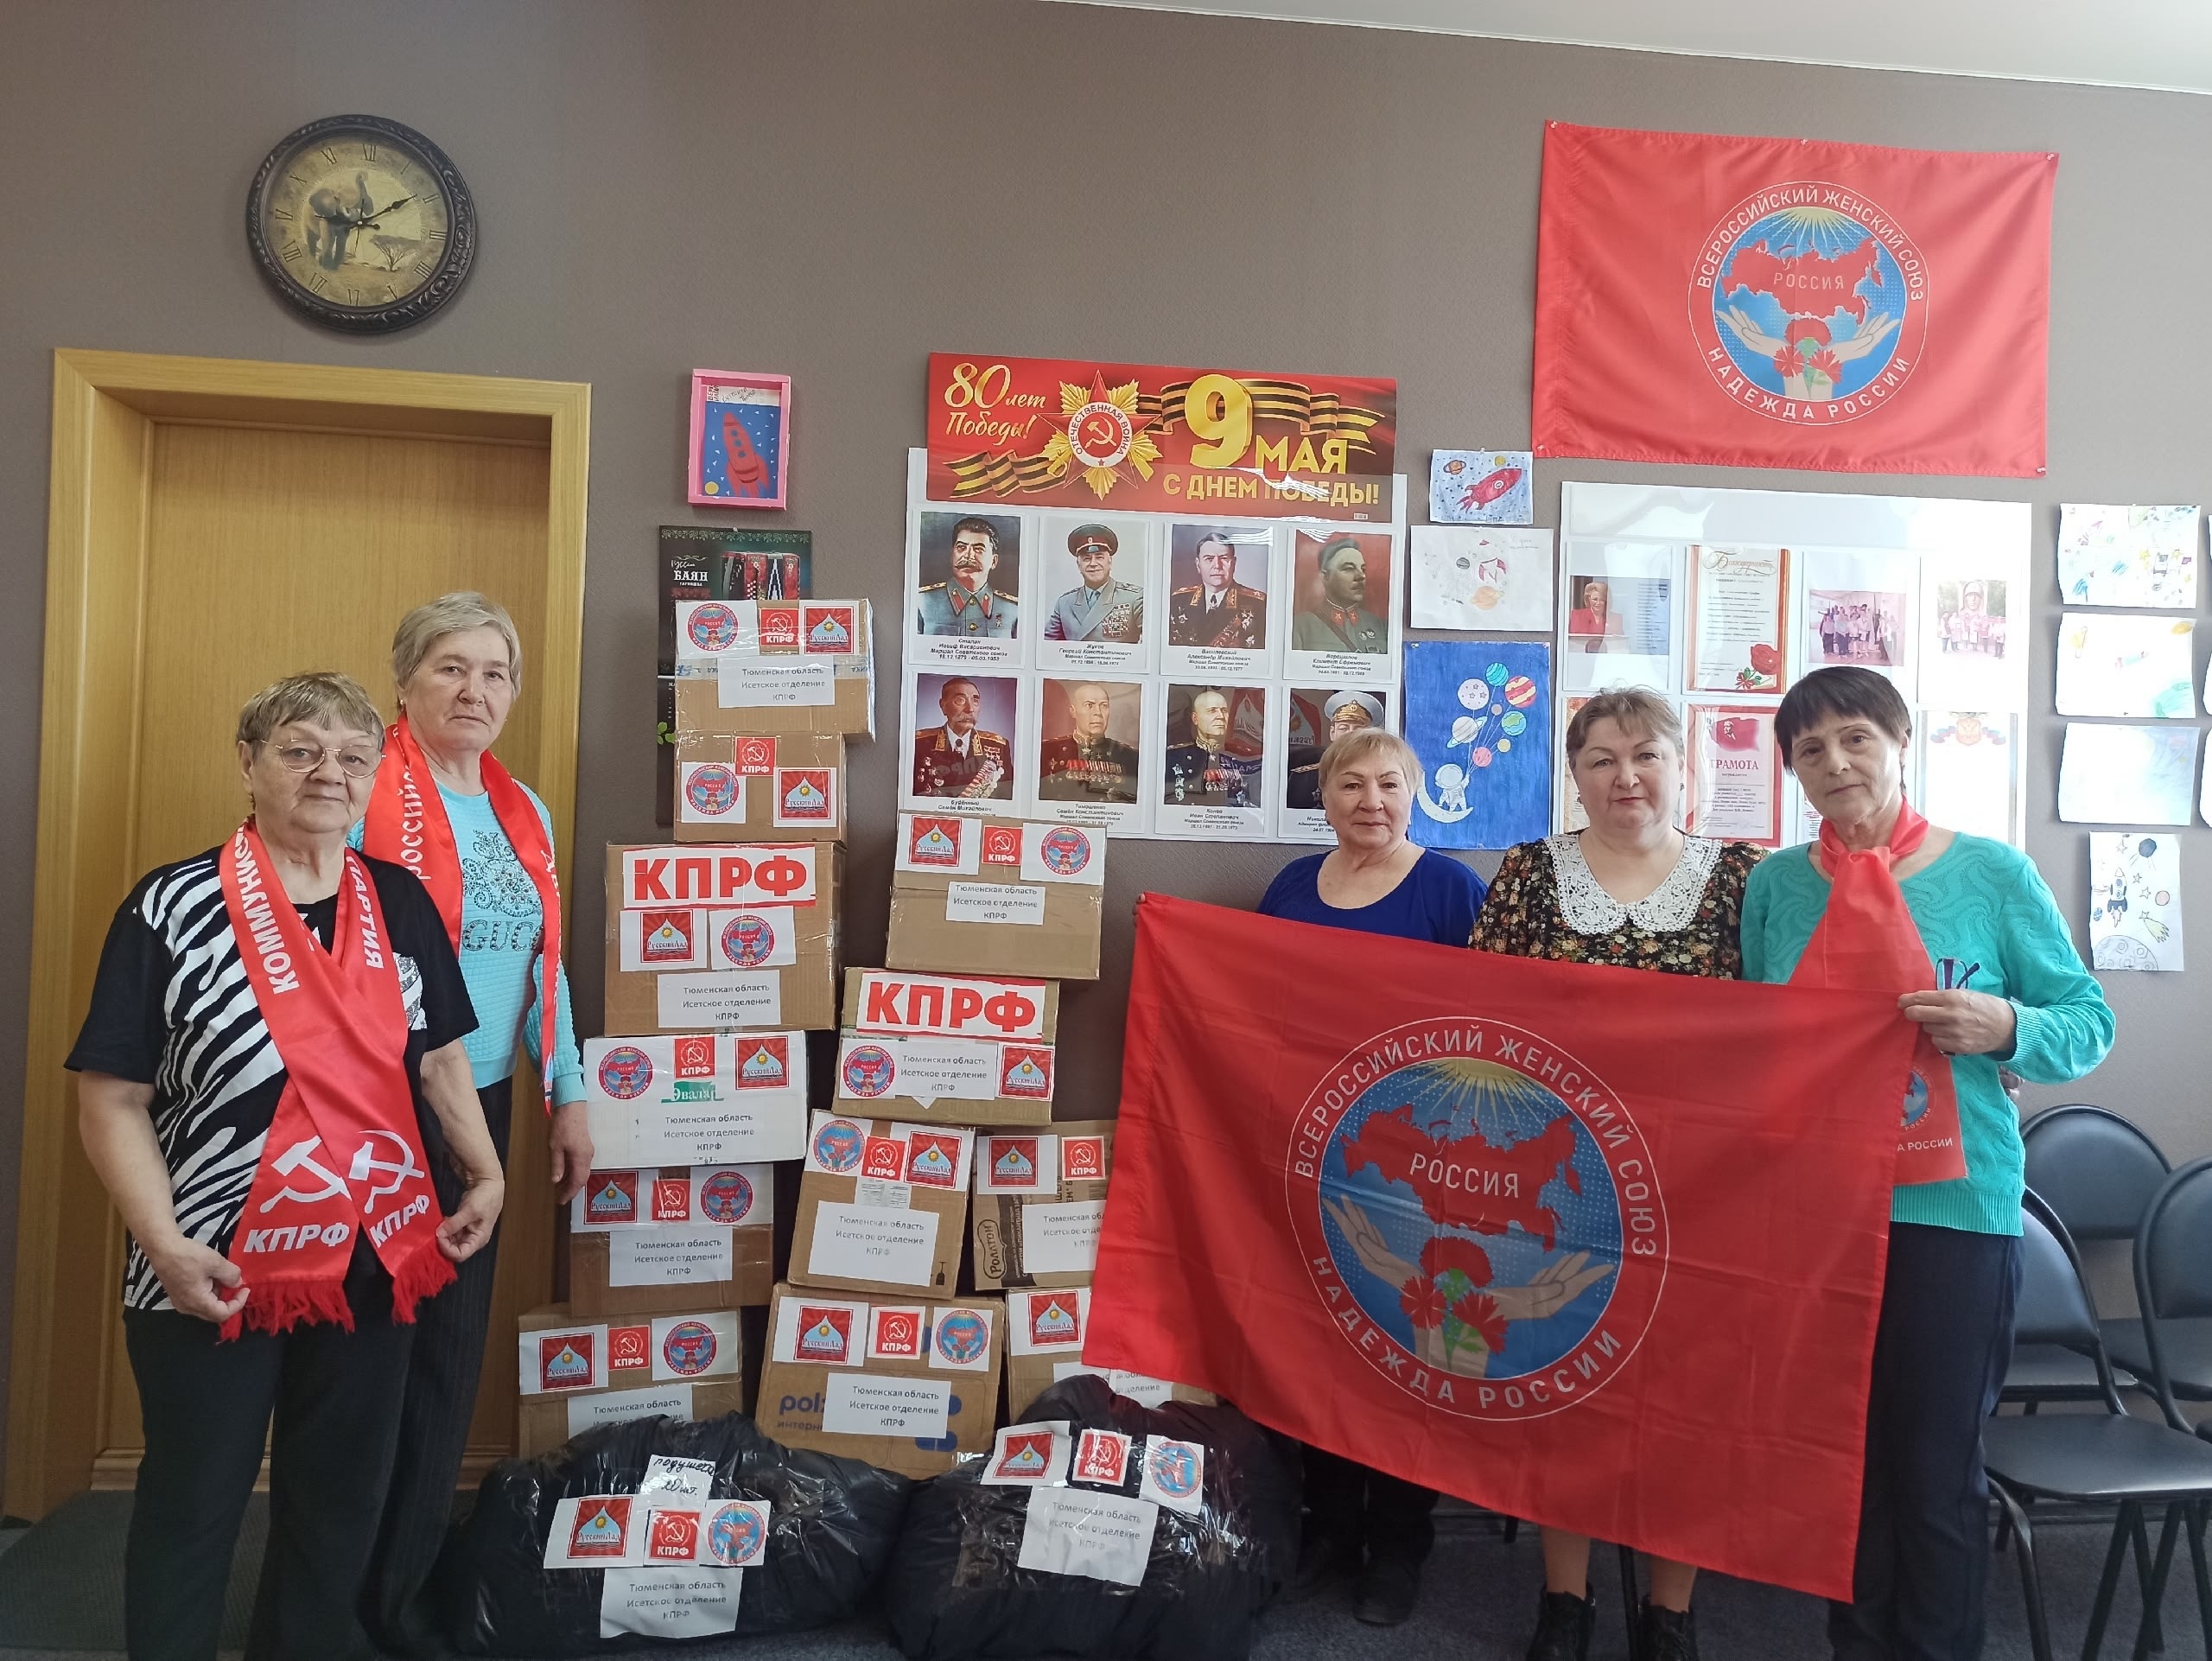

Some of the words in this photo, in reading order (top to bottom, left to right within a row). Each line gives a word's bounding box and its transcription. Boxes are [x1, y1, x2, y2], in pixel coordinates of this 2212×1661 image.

[1697, 185, 1818, 289] ВСЕРОССИЙСКИЙ
[1822, 190, 1904, 250] ЖЕНСКИЙ
[1897, 249, 1924, 301] СОЮЗ
[1773, 273, 1845, 290] РОССИЯ
[944, 362, 1011, 409] 80
[1005, 394, 1046, 408] лет
[1708, 347, 1815, 419] НАДЕЖДА
[1827, 359, 1910, 417] РОССИИ
[946, 411, 1038, 445] Победы!
[1071, 405, 1123, 455] ОТЕЧЕСТВЕННАЯ
[1116, 422, 1130, 455] ВОЙНА
[1185, 374, 1253, 468] 9
[1255, 435, 1347, 474] МАЯ
[1163, 474, 1180, 494] С
[1186, 475, 1257, 500] ДНЕМ
[1264, 479, 1379, 506] ПОБЕДЫ!
[674, 570, 708, 582] БАЯН
[766, 634, 794, 643] КПРФ
[741, 765, 770, 773] КПРФ
[1710, 759, 1758, 770] ГРАМОТА
[988, 853, 1015, 862] КПРФ
[634, 855, 807, 901] КПРФ
[956, 885, 1002, 894] Тюменская
[954, 898, 991, 907] Исетское
[346, 856, 385, 968] ПАРТИЯ
[684, 986, 733, 995] Тюменская
[683, 1000, 722, 1009] Исетское
[725, 998, 771, 1007] отделение
[867, 981, 1036, 1032] КПРФ
[715, 1012, 740, 1021] КПРФ
[903, 1055, 950, 1064] Тюменская
[681, 1066, 710, 1076] КПРФ
[665, 1116, 715, 1124] Тюменская
[1905, 1107, 1931, 1132] РОССИИ
[664, 1130, 704, 1138] Исетское
[707, 1128, 754, 1136] отделение
[697, 1142, 721, 1151] КПРФ
[1294, 1025, 1484, 1179] ВСЕРОССИЙСКИЙ
[1496, 1035, 1634, 1149] ЖЕНСКИЙ
[1618, 1158, 1657, 1256] СОЮЗ
[1908, 1137, 1953, 1151] РОССИИ
[868, 1167, 896, 1177] КПРФ
[1071, 1167, 1096, 1175] КПРФ
[1409, 1154, 1519, 1198] РОССИЯ
[658, 1210, 686, 1219] КПРФ
[369, 1194, 429, 1248] КПРФ
[839, 1216, 887, 1227] Тюменская
[891, 1221, 924, 1231] область
[243, 1222, 349, 1253] КПРФ
[877, 1234, 924, 1244] отделение
[1313, 1257, 1454, 1403] НАДЕЖДА
[1478, 1329, 1622, 1409] РОССИИ
[881, 1342, 911, 1352] КПРФ
[614, 1358, 644, 1367] КПРФ
[853, 1386, 902, 1397] Тюменская
[905, 1391, 939, 1399] область
[594, 1403, 644, 1414] Тюменская
[647, 1399, 681, 1408] область
[779, 1392, 825, 1416] pol
[849, 1401, 889, 1411] Исетское
[892, 1405, 938, 1414] отделение
[777, 1421, 823, 1431] интерн
[1084, 1466, 1114, 1478] КПРФ
[1053, 1502, 1103, 1516] Тюменская
[1106, 1511, 1141, 1524] область
[1091, 1525, 1140, 1539] отделение
[657, 1546, 689, 1556] КПРФ
[630, 1582, 685, 1592] Тюменская
[688, 1581, 726, 1589] область
[675, 1595, 726, 1606] отделение
